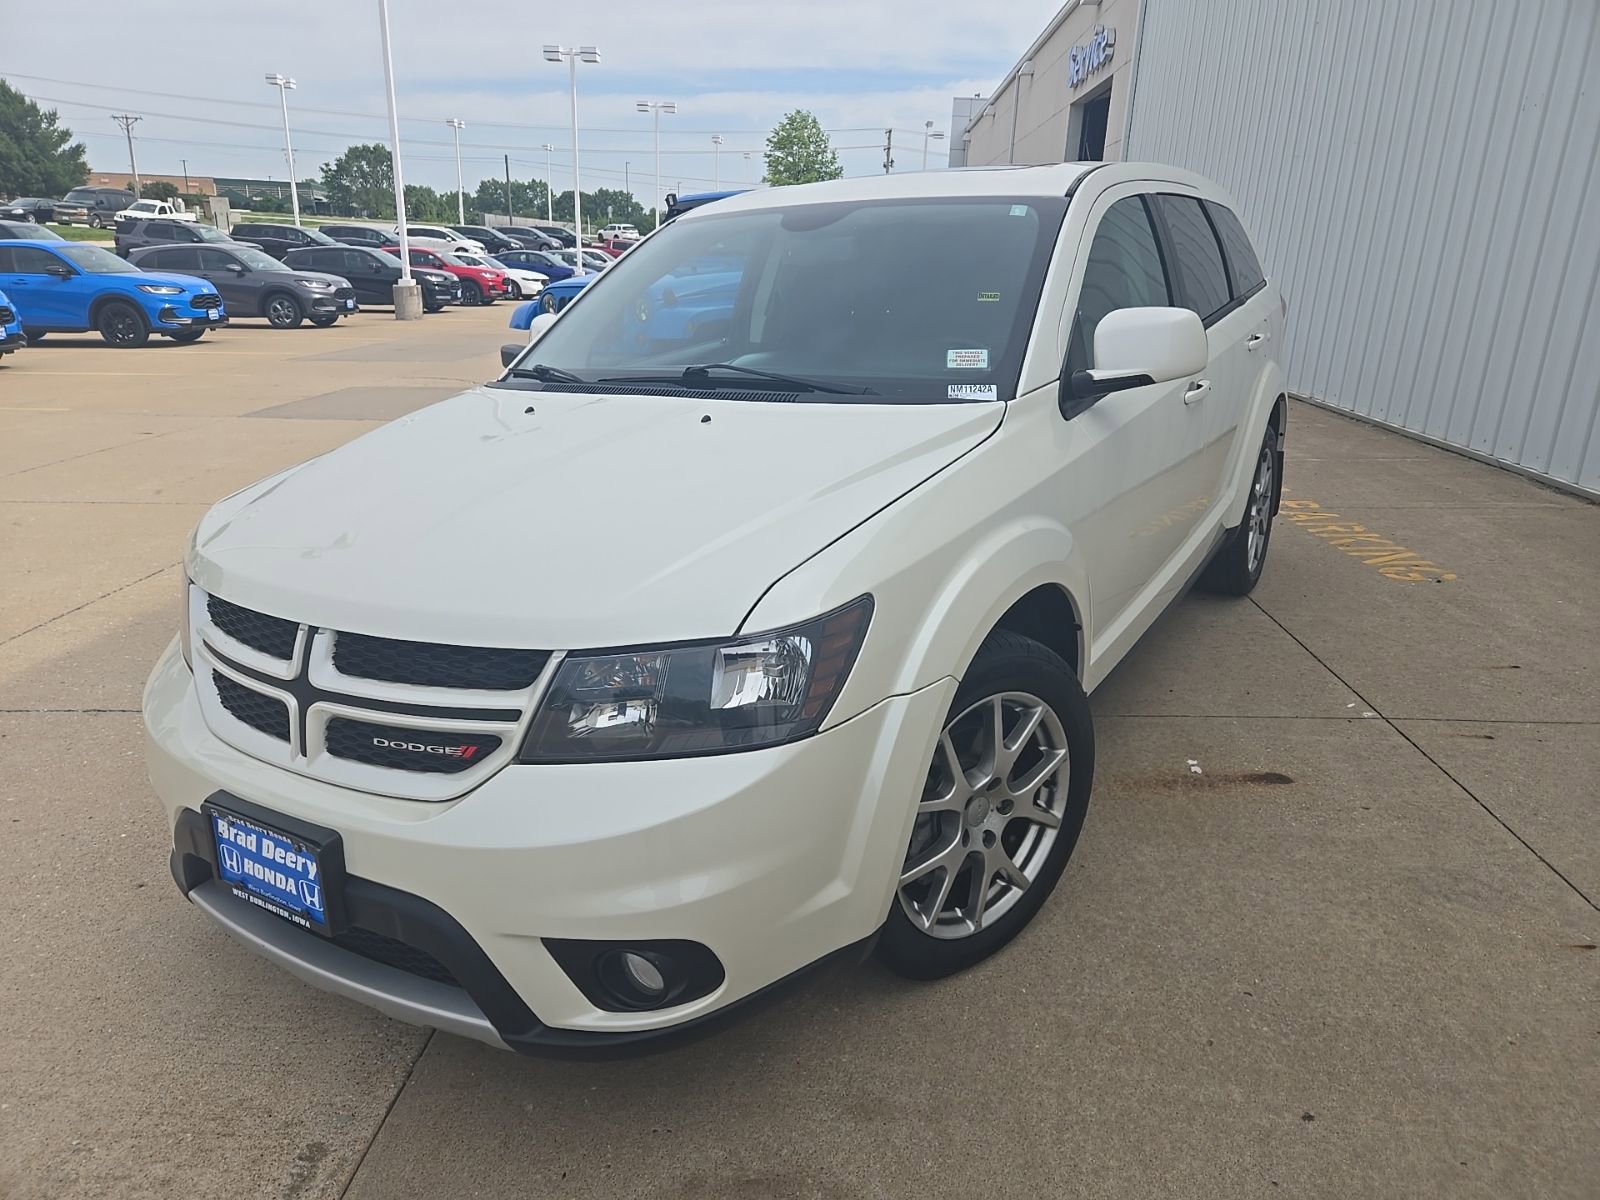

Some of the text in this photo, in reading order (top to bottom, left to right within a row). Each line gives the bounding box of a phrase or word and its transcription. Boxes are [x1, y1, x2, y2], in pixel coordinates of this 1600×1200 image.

[950, 384, 993, 394] NM11242A
[373, 737, 463, 756] DODGE
[217, 819, 317, 880] Brad Deery
[244, 858, 297, 895] HONDA
[232, 888, 249, 900] WEST
[292, 915, 311, 928] IOWA
